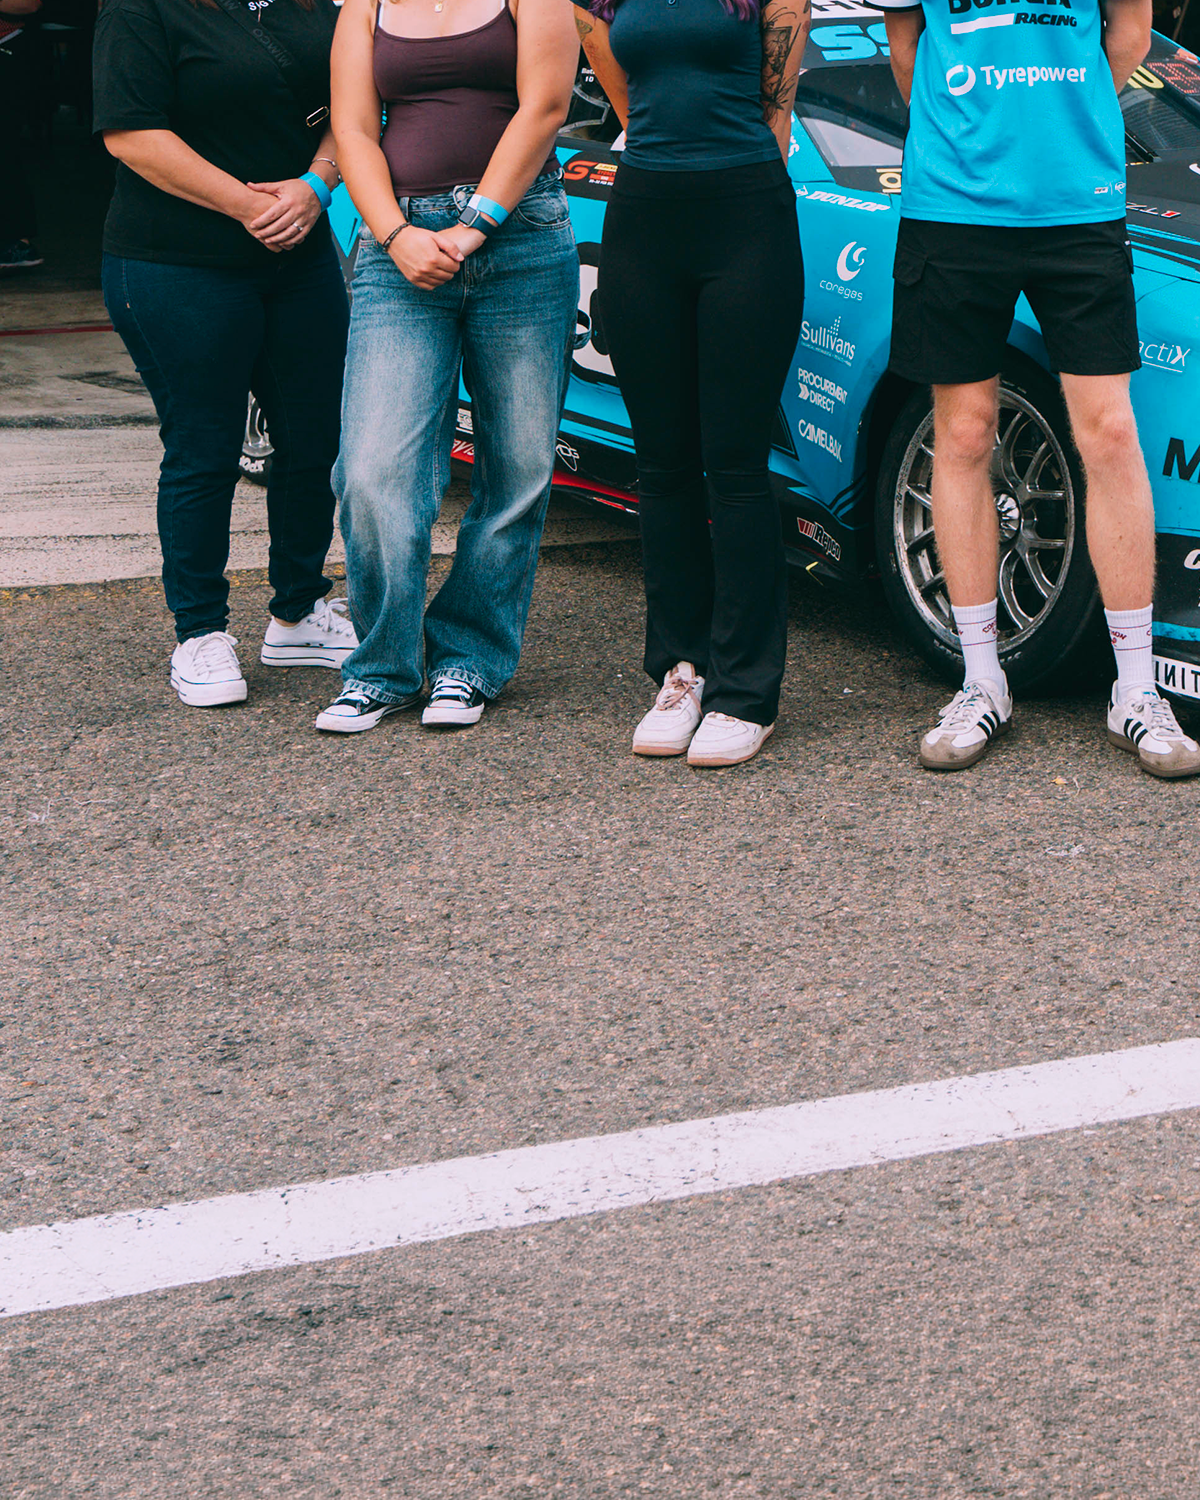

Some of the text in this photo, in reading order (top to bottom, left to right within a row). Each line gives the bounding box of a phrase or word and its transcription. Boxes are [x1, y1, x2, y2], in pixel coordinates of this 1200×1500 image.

[1014, 12, 1077, 27] RACING
[980, 65, 1087, 90] Tyrepower
[805, 190, 891, 212] DUNLOP
[819, 279, 863, 301] coregas
[801, 320, 856, 360] Sullivans
[798, 367, 848, 405] PROCUREMENT
[809, 389, 835, 414] DIRECT
